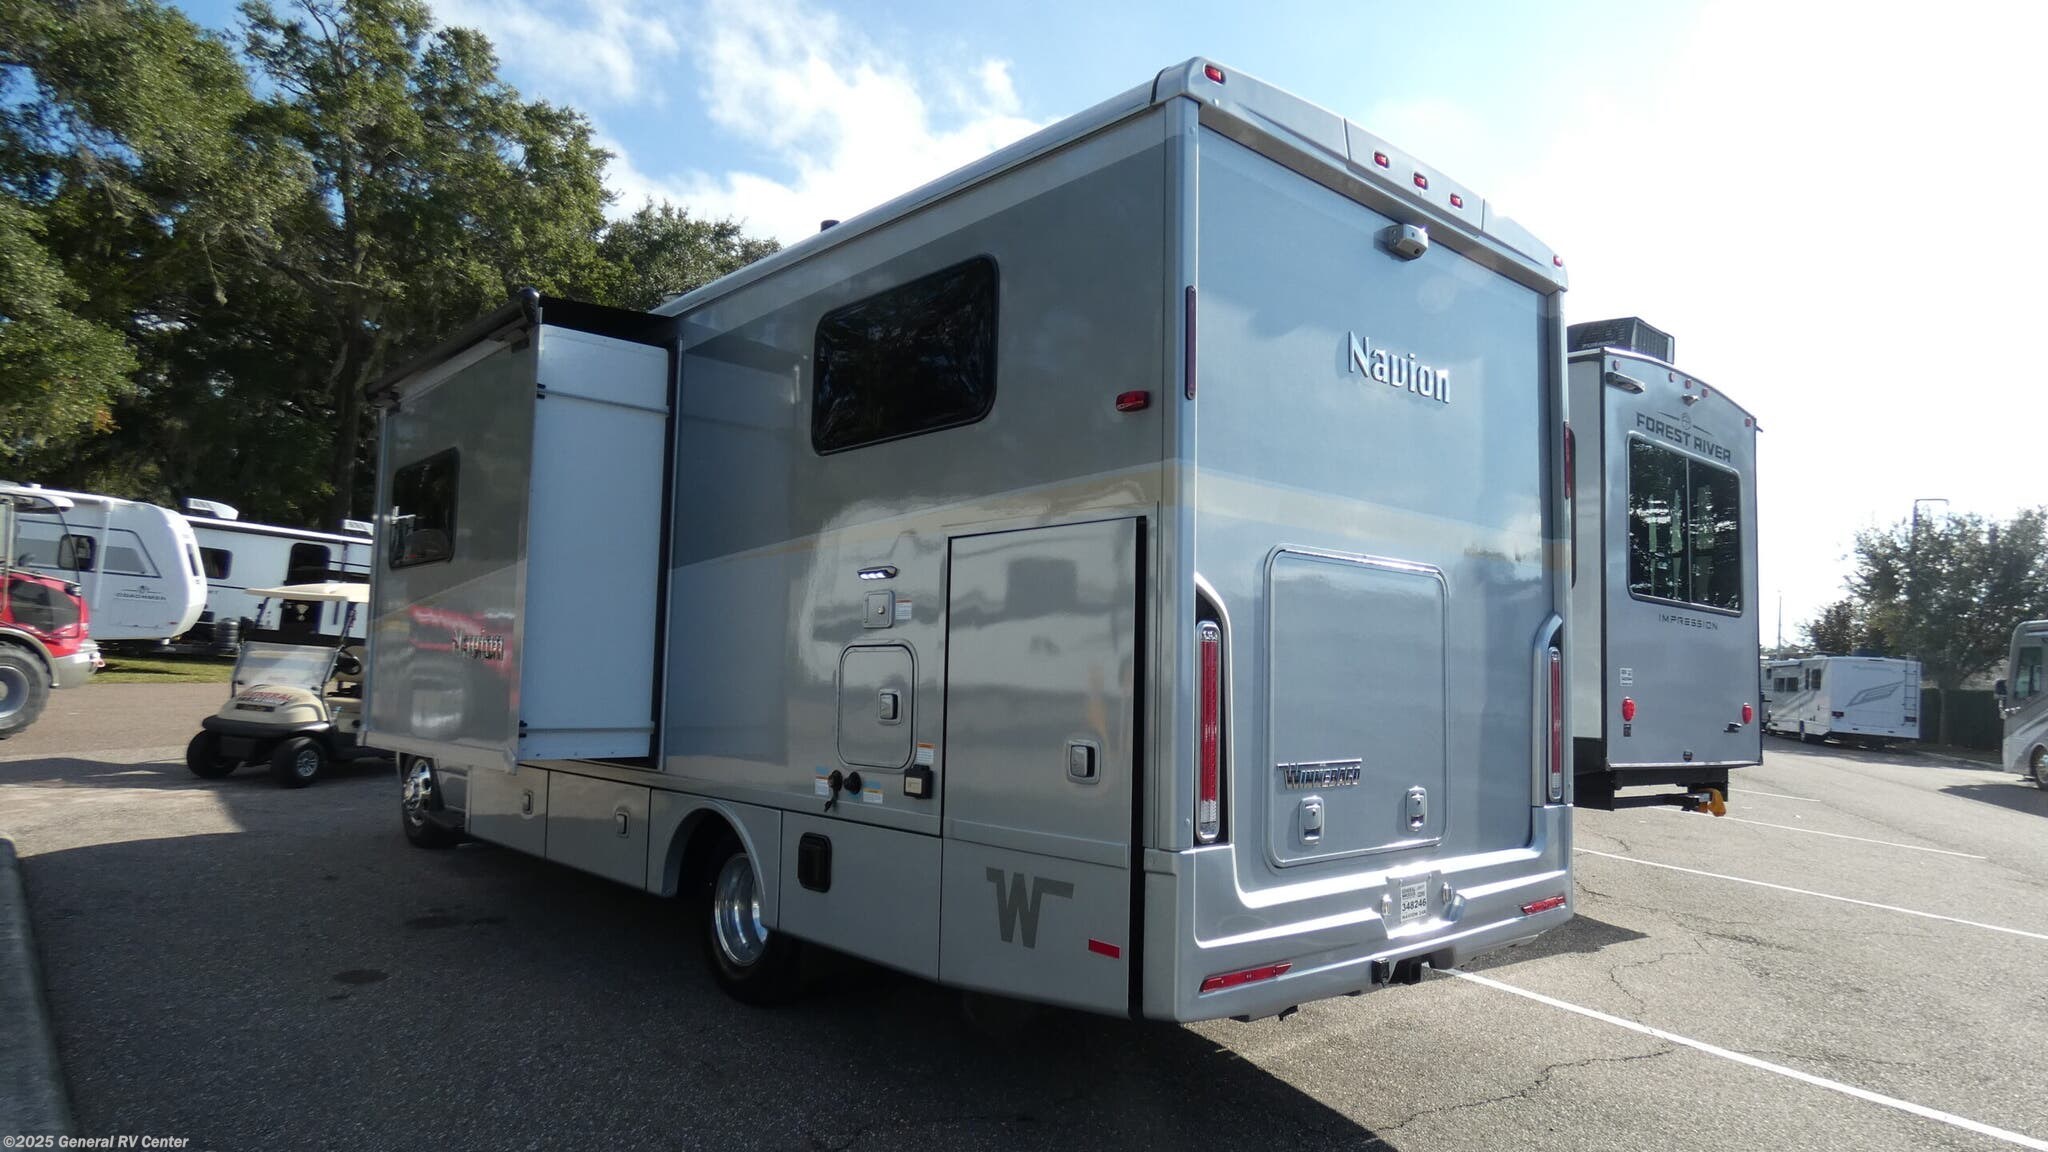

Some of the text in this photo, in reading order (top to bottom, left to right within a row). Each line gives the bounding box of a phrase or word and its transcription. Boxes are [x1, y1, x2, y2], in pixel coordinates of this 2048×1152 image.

[1347, 330, 1450, 404] Navion
[1636, 411, 1731, 463] FOREST RIVER
[1658, 613, 1718, 631] IMPRESSION
[1277, 757, 1362, 790] WINNEBAGO
[1402, 898, 1427, 912] 348246
